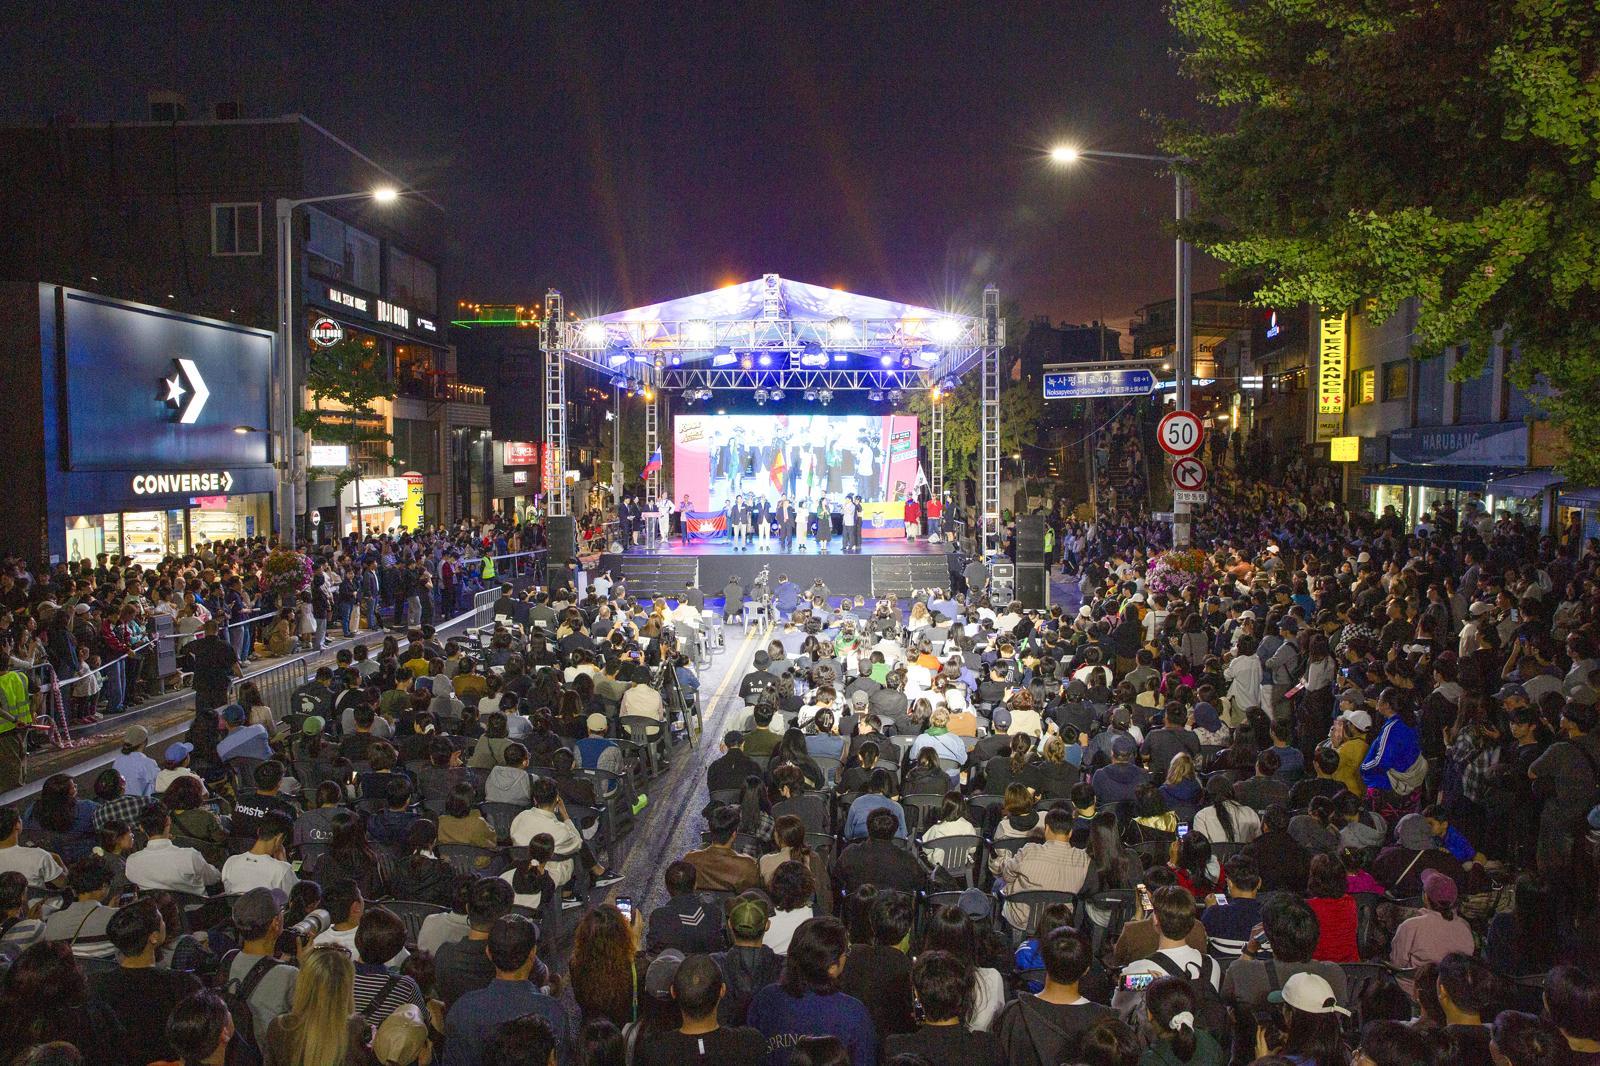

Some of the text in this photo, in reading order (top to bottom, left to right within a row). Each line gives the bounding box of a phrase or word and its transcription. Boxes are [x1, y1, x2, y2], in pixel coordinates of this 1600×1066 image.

[1322, 338, 1342, 393] EXCHANGE
[1169, 422, 1193, 445] 50
[1423, 432, 1480, 450] HARUBANG
[132, 473, 219, 495] CONVERSE
